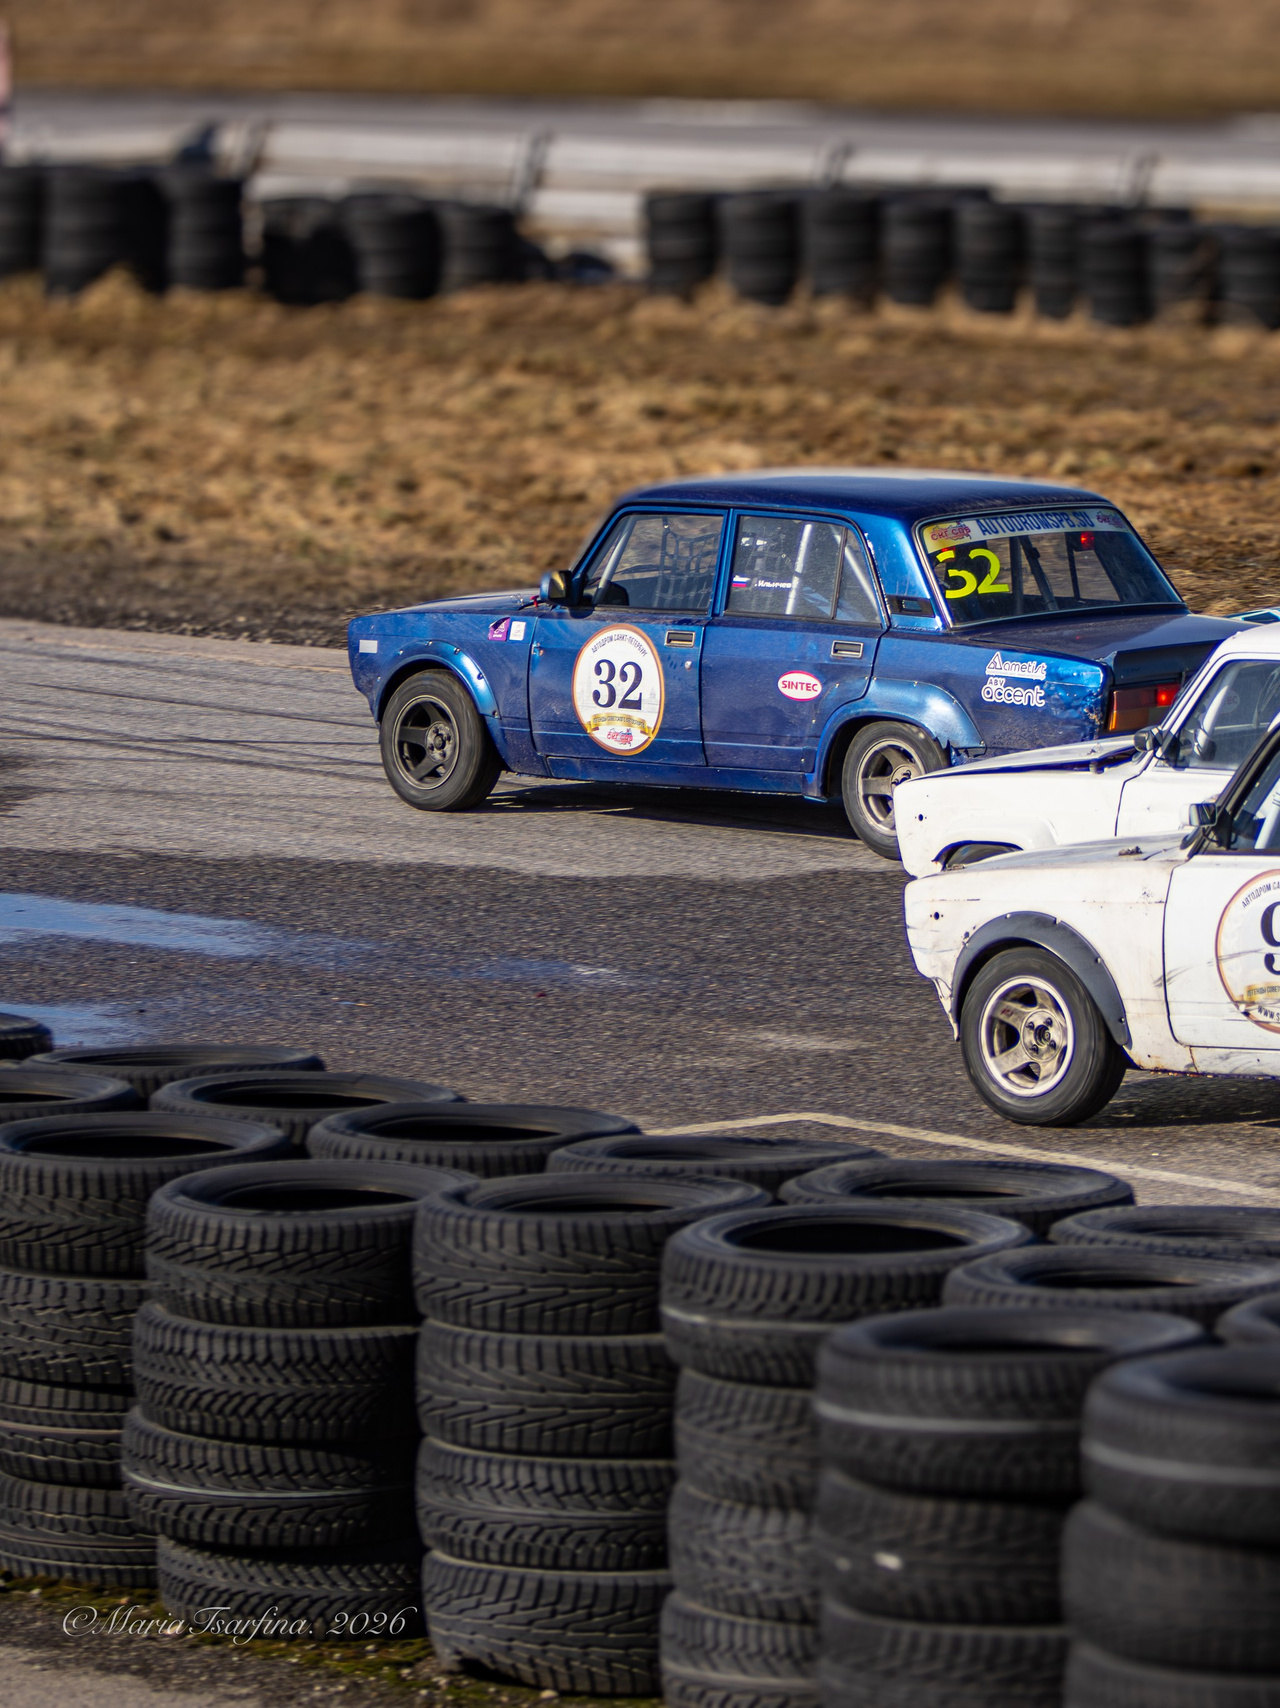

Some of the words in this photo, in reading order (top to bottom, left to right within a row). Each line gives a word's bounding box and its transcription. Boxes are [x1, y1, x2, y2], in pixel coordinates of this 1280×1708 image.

[976, 511, 1095, 536] AUTODROMSPB.SU
[592, 659, 643, 710] 32
[781, 680, 818, 692] SINTEC
[982, 684, 1045, 706] accent
[1241, 883, 1272, 909] АВТОДРОМ
